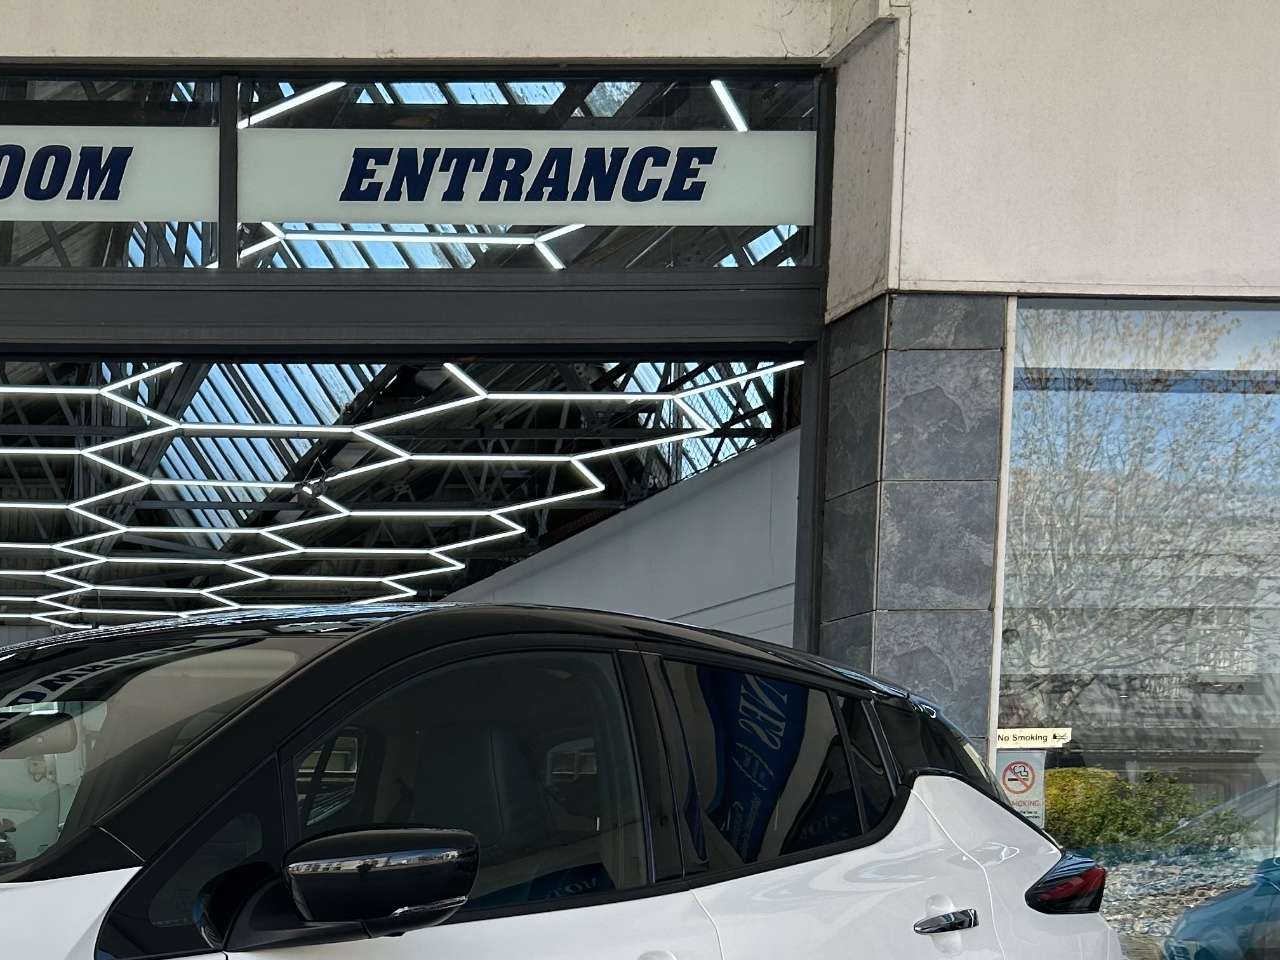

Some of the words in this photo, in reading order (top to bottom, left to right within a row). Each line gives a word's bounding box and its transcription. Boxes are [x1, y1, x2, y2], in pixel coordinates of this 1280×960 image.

[339, 145, 718, 202] ENTRANCE
[997, 734, 1010, 742] No
[1012, 733, 1048, 743] Smoking
